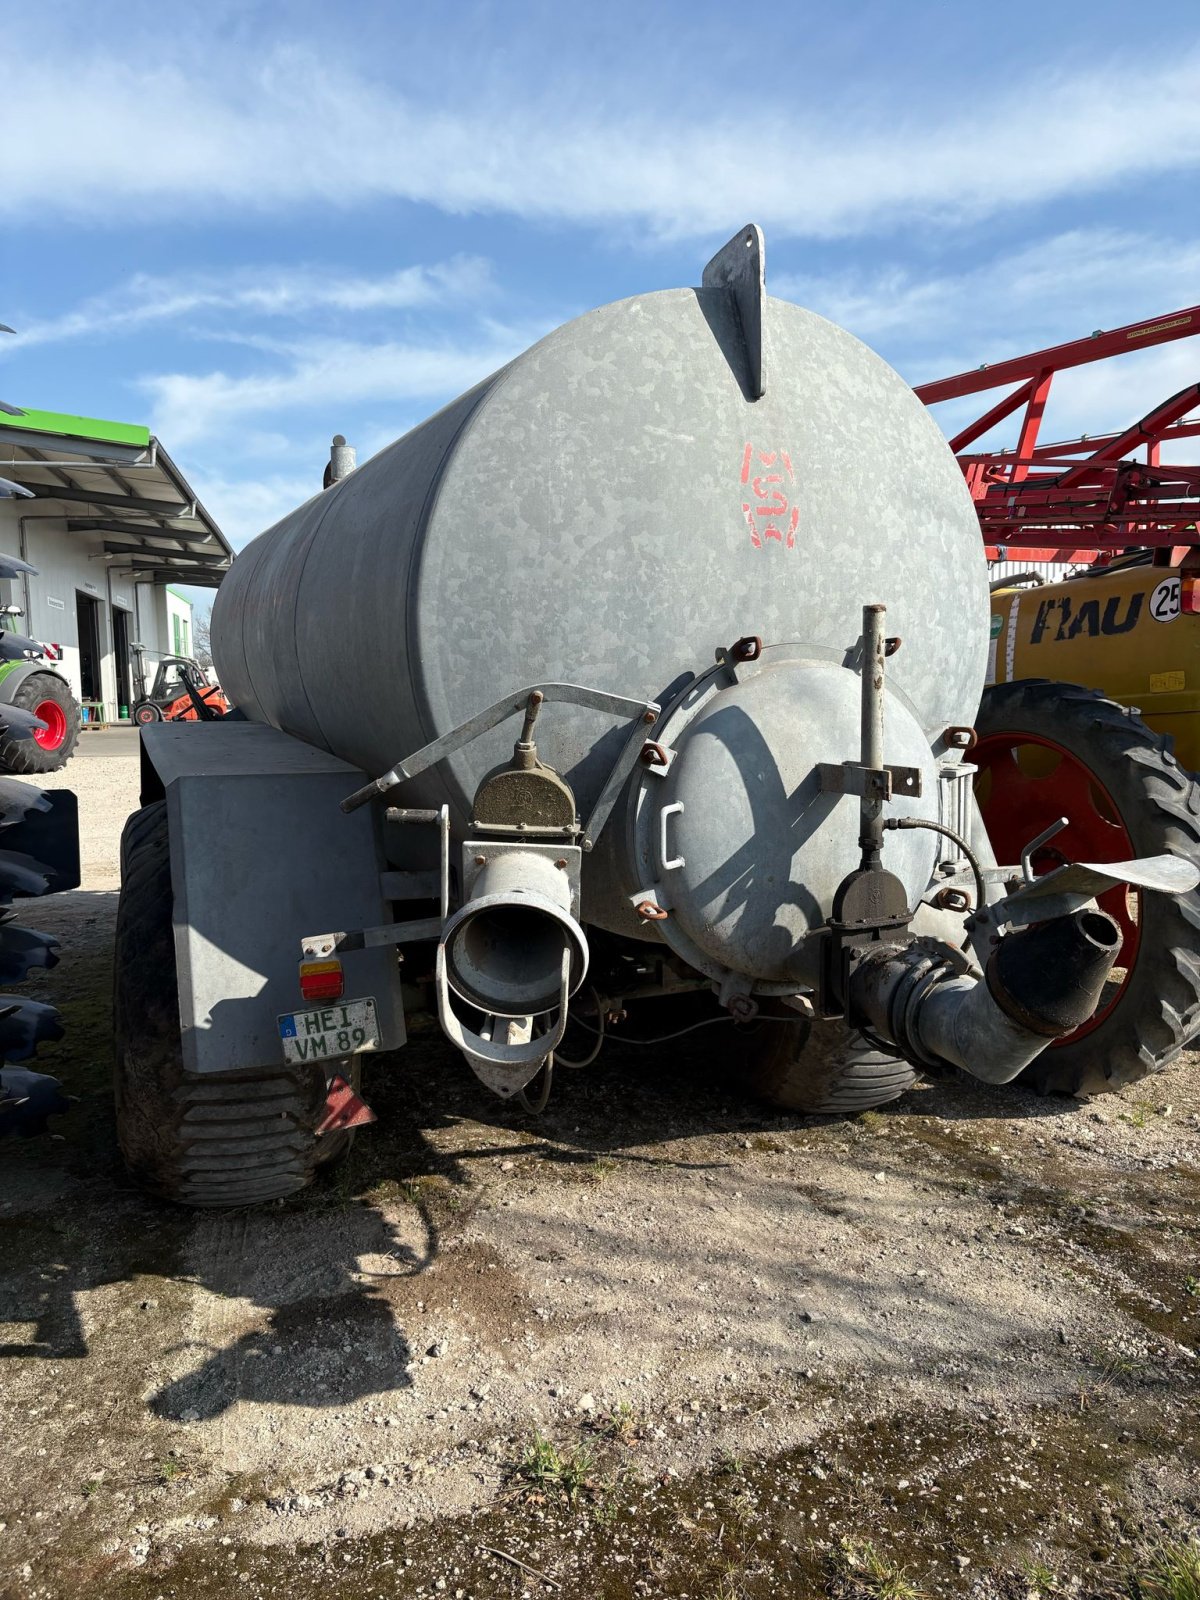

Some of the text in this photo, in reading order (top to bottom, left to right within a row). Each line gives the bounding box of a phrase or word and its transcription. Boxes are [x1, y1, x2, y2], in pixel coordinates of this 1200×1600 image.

[304, 1007, 352, 1035] HEI
[294, 1028, 366, 1060] VM 89
